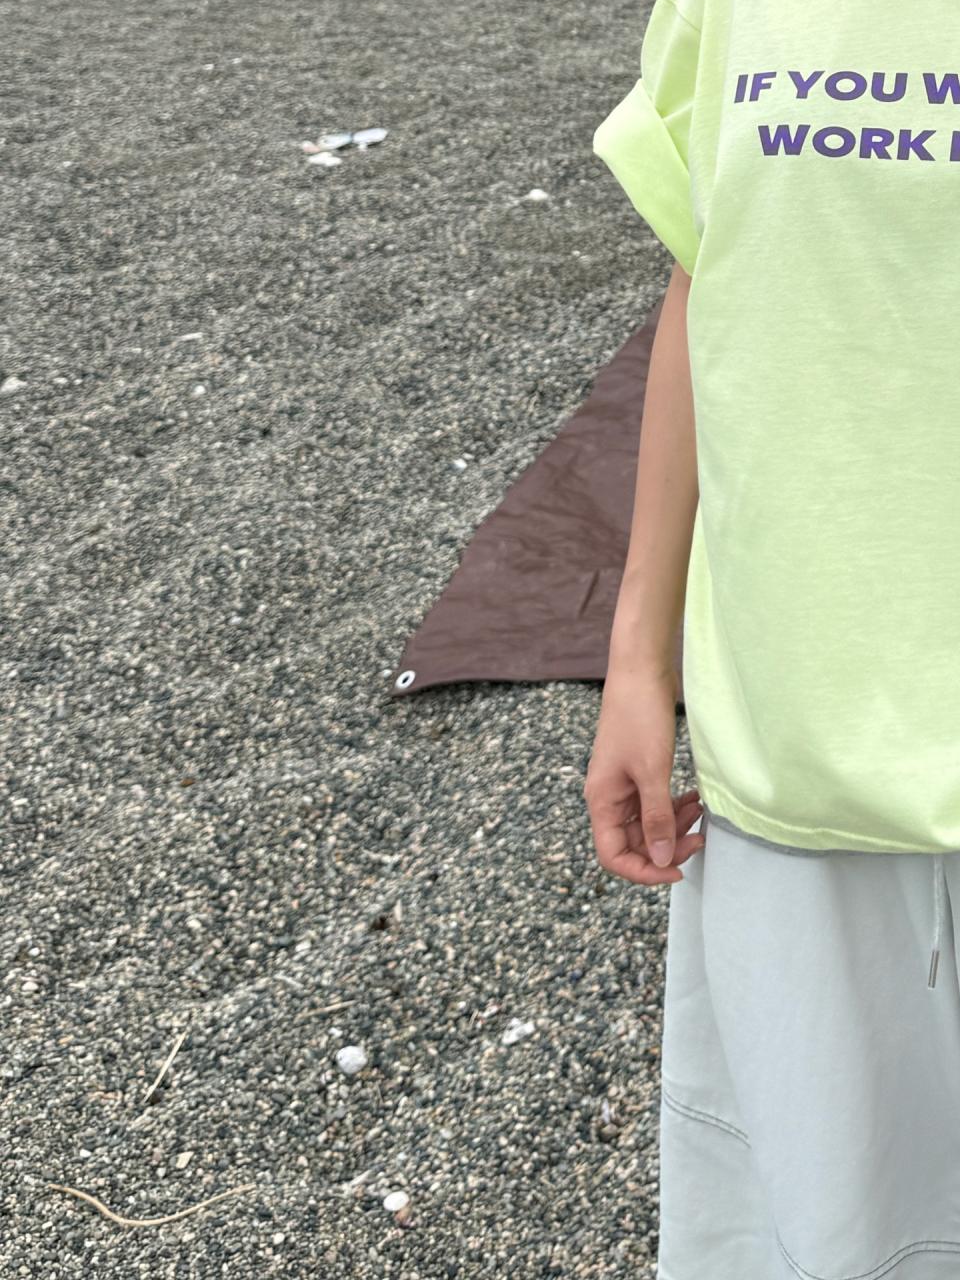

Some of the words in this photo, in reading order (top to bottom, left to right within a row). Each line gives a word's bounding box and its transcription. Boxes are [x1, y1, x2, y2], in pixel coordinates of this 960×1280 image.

[734, 71, 777, 103] IF
[787, 70, 908, 103] YOU
[757, 124, 937, 162] WORK
